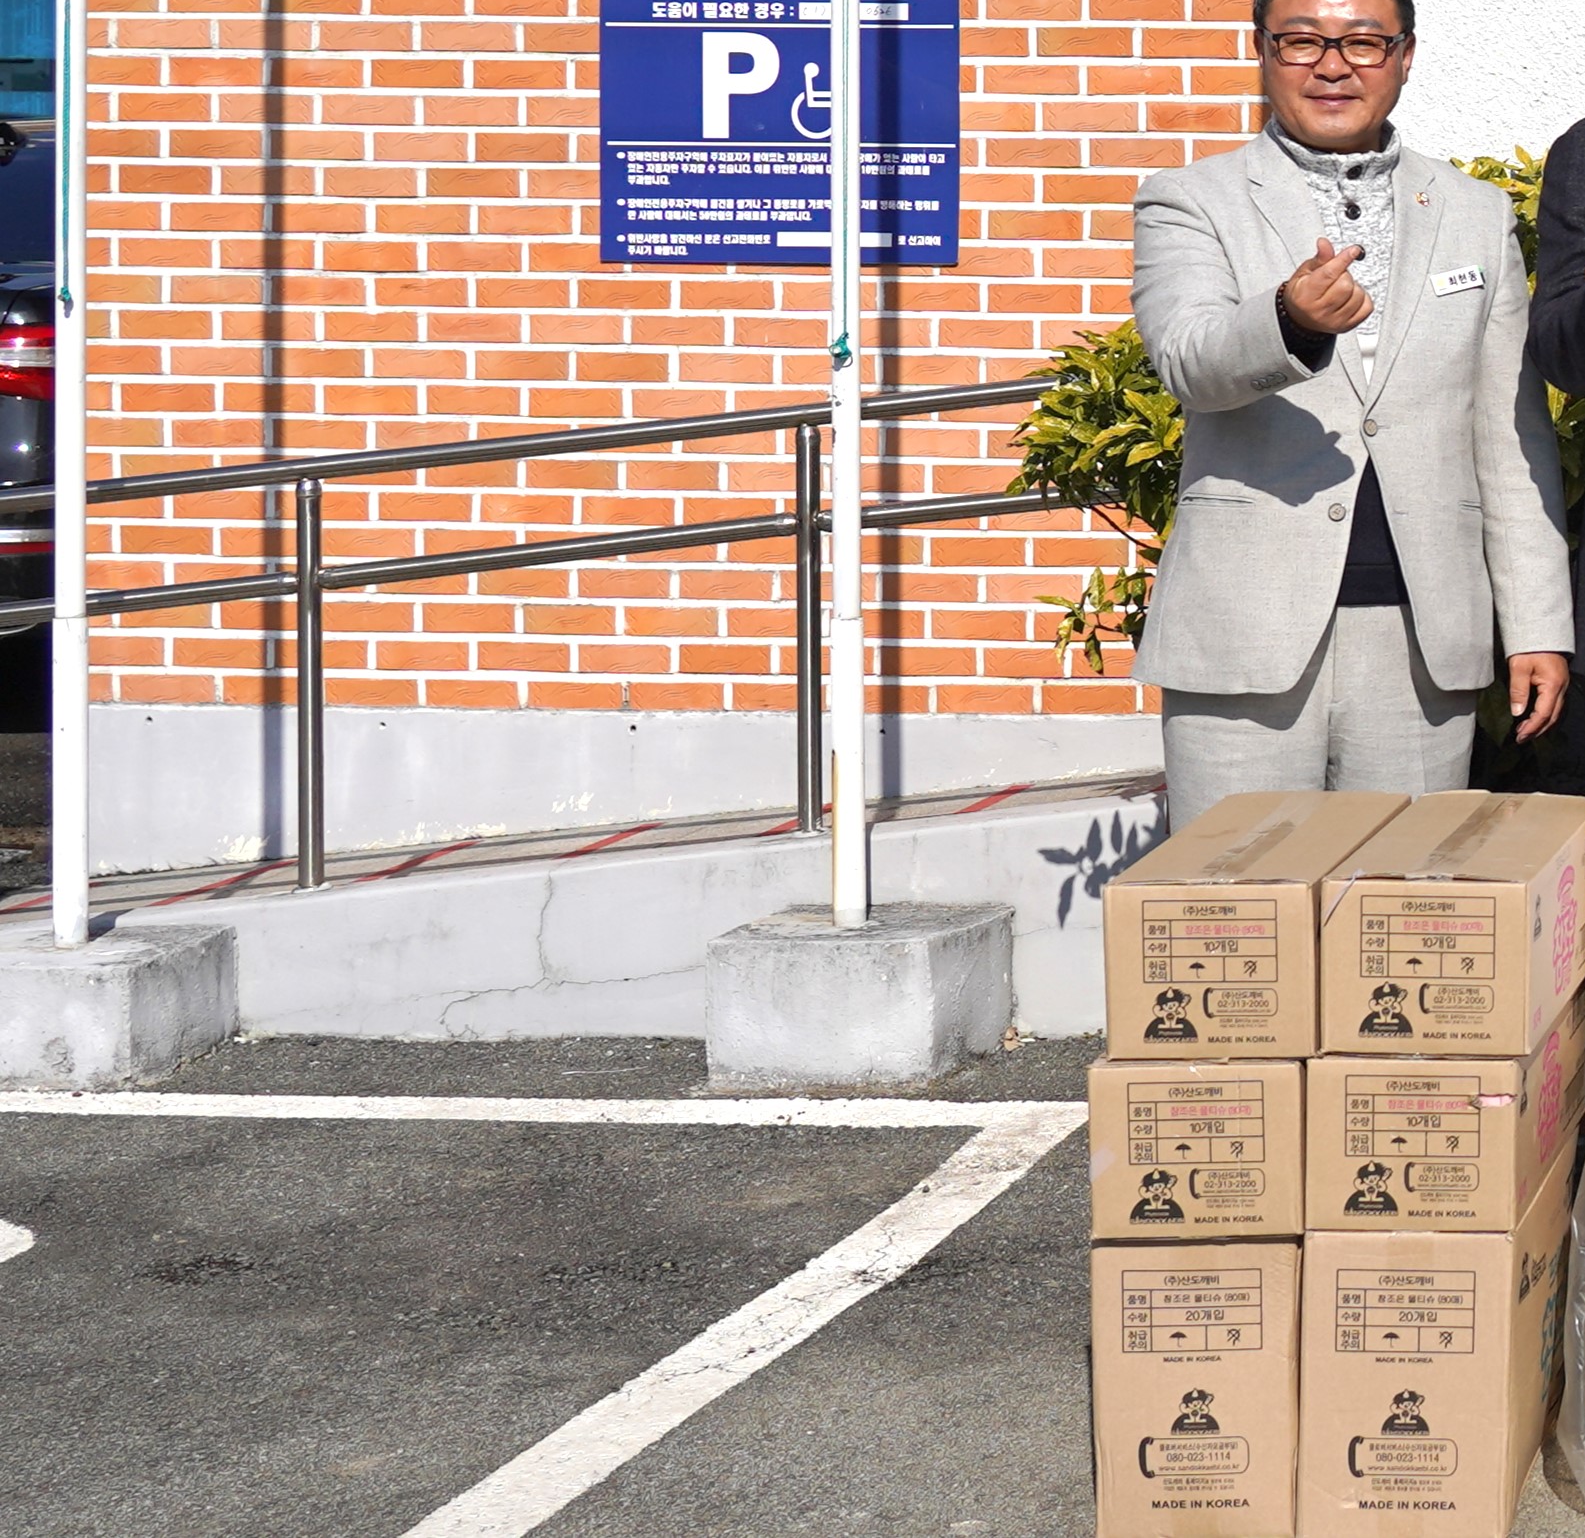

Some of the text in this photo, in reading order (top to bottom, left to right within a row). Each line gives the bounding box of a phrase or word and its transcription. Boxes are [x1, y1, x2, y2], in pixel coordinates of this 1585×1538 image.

[651, 1, 785, 19] 도움이 필요한 경우
[702, 31, 780, 139] P
[1422, 1031, 1448, 1039] MADE
[1461, 1032, 1492, 1040] KOREA
[1232, 1215, 1264, 1223] KOREA
[1407, 1210, 1477, 1218] MADE IN KOREA
[1185, 1309, 1225, 1322] 20개입
[1398, 1311, 1438, 1322] 20개입
[1166, 1452, 1231, 1463] 080-023-1114
[1376, 1452, 1440, 1463] 080-023-1114
[1151, 1499, 1250, 1509] MADE IN KOREA
[1358, 1500, 1457, 1510] MADE IN KOREA
